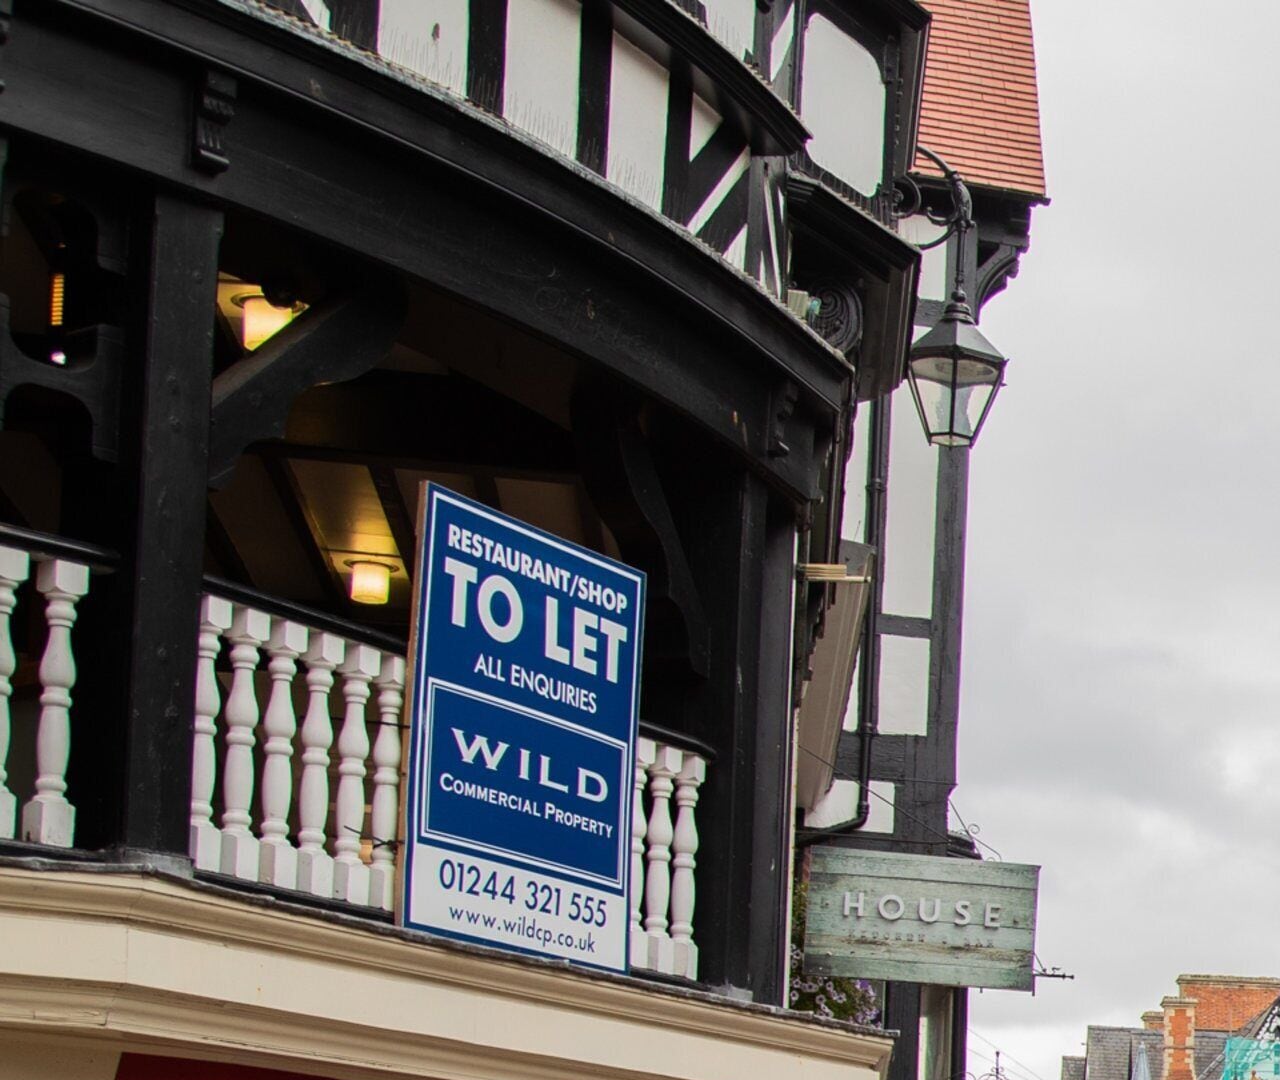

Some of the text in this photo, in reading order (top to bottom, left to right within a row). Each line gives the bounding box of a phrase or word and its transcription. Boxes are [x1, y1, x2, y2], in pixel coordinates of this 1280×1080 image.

[448, 523, 628, 614] RESTAURANT/SHOP
[444, 555, 628, 683] TO LET
[474, 654, 597, 714] ALL ENQUIRIES
[450, 727, 608, 803] WILD
[439, 773, 613, 838] COMMERCIAL PROPERTY
[439, 858, 607, 928] 01244 321 555
[842, 891, 1002, 929] HOUSE
[448, 904, 597, 953] www.wildcp.co.uk
